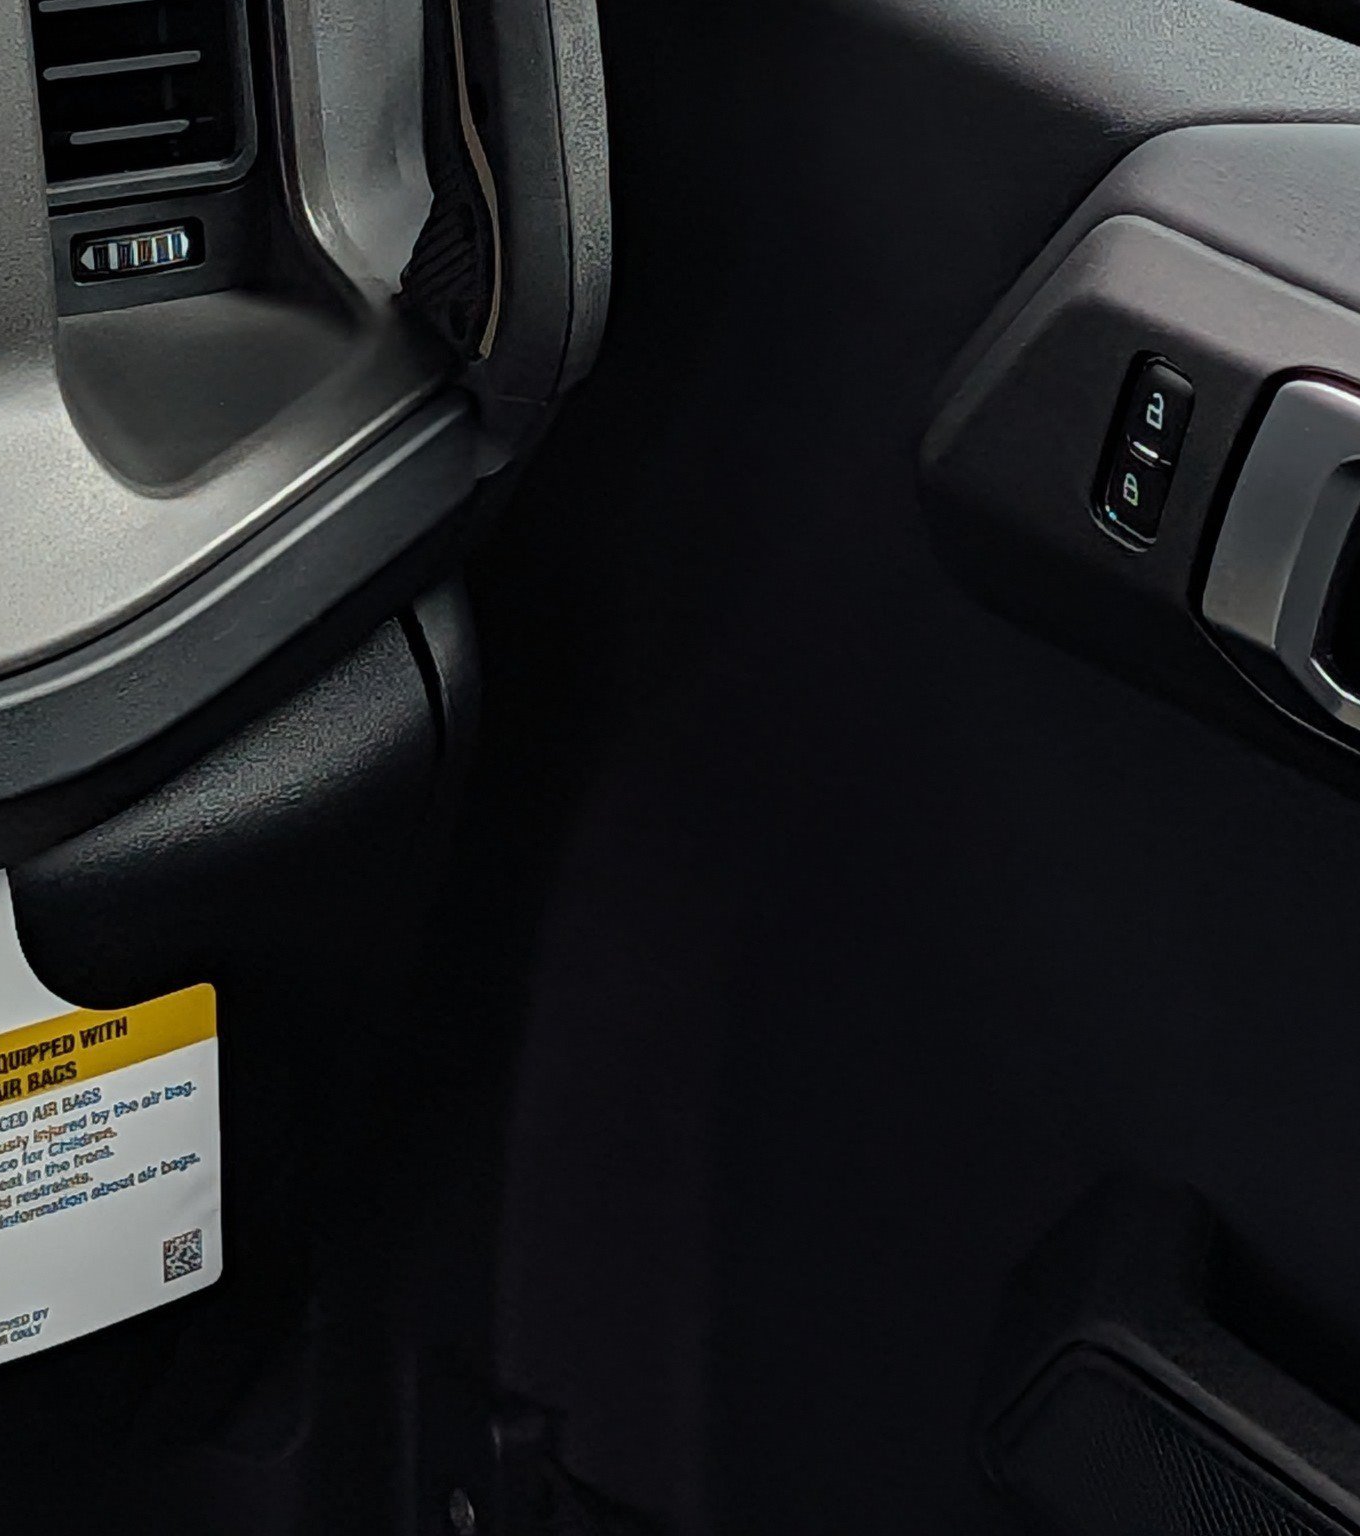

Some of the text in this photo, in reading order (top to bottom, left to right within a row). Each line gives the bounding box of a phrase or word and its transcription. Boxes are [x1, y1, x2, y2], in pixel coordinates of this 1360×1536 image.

[80, 1016, 129, 1050] WITH
[27, 1061, 77, 1090] BAGS
[32, 1100, 58, 1120] AIR
[62, 1087, 101, 1112] BAGS
[91, 1107, 109, 1126] by
[113, 1098, 138, 1115] the
[141, 1090, 160, 1106] air
[26, 1167, 40, 1181] in
[45, 1158, 69, 1175] the
